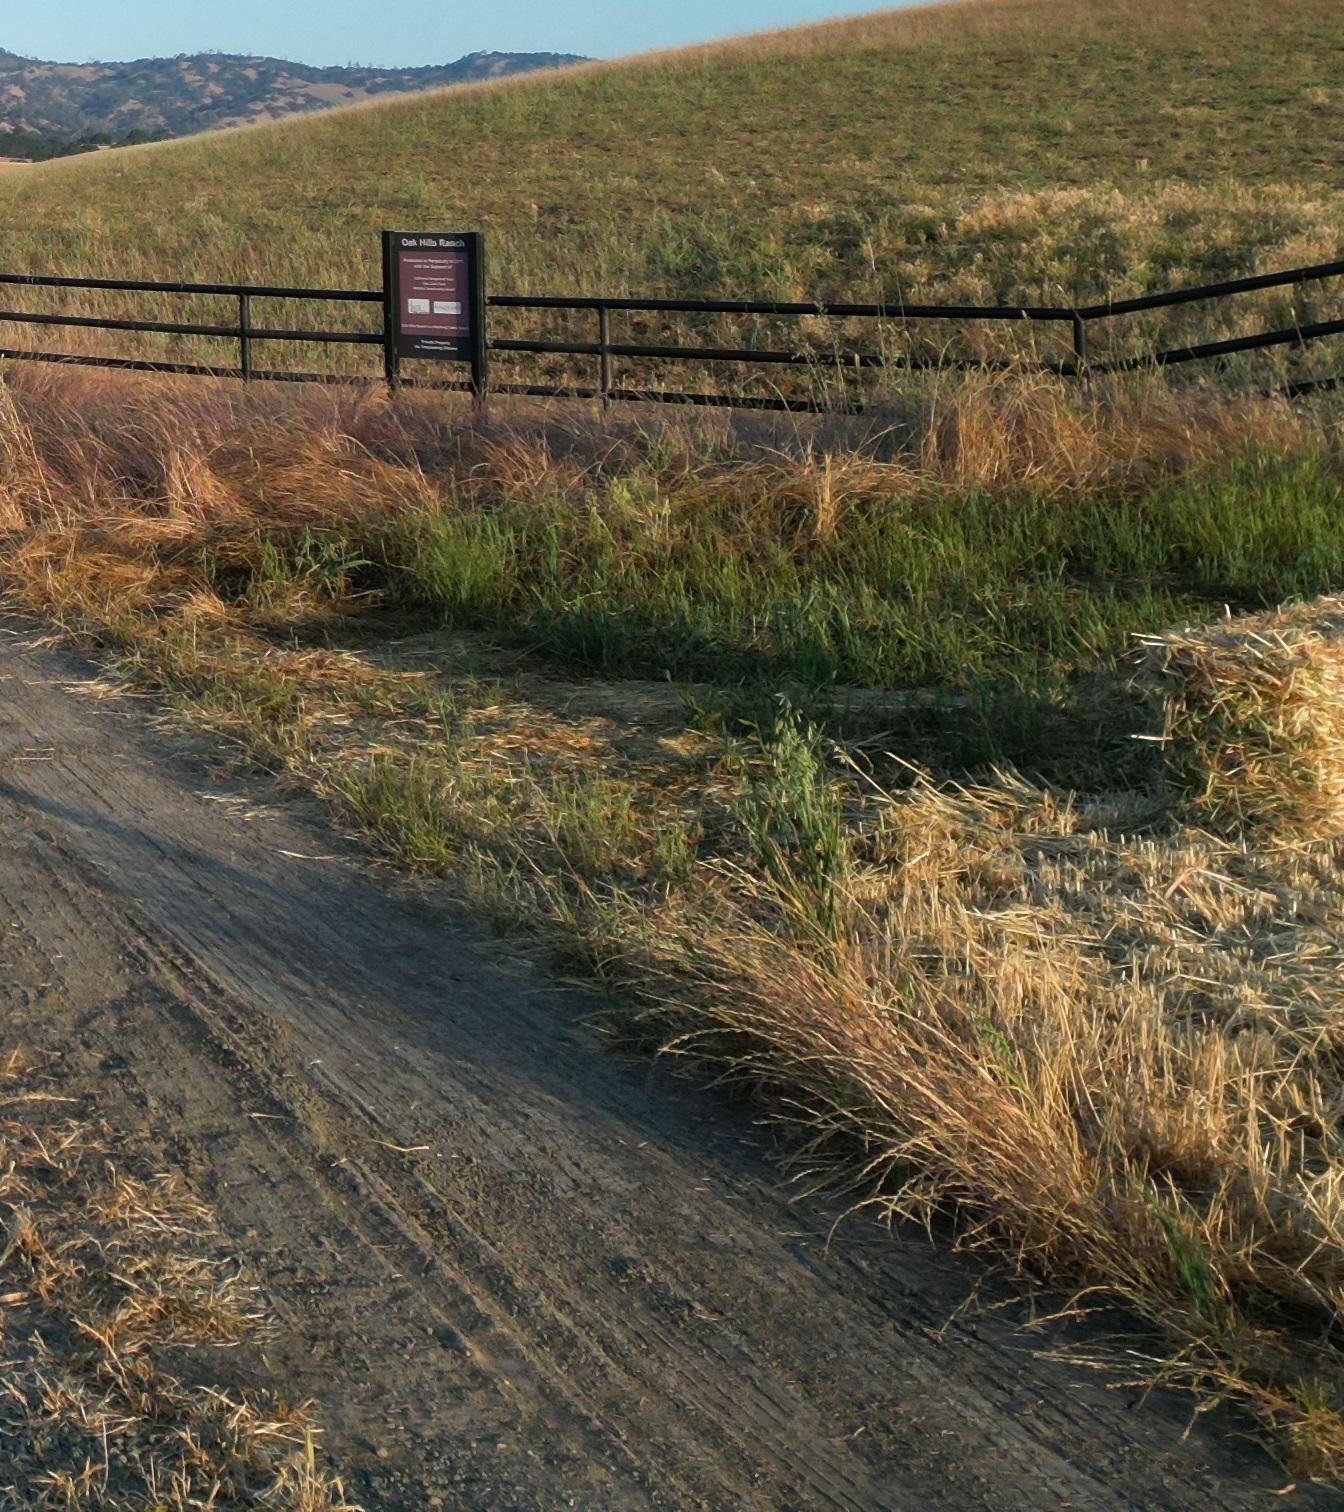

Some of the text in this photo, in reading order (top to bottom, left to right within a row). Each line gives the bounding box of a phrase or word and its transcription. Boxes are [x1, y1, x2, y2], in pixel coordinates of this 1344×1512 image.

[401, 238, 465, 248] Oak Hills Ranch
